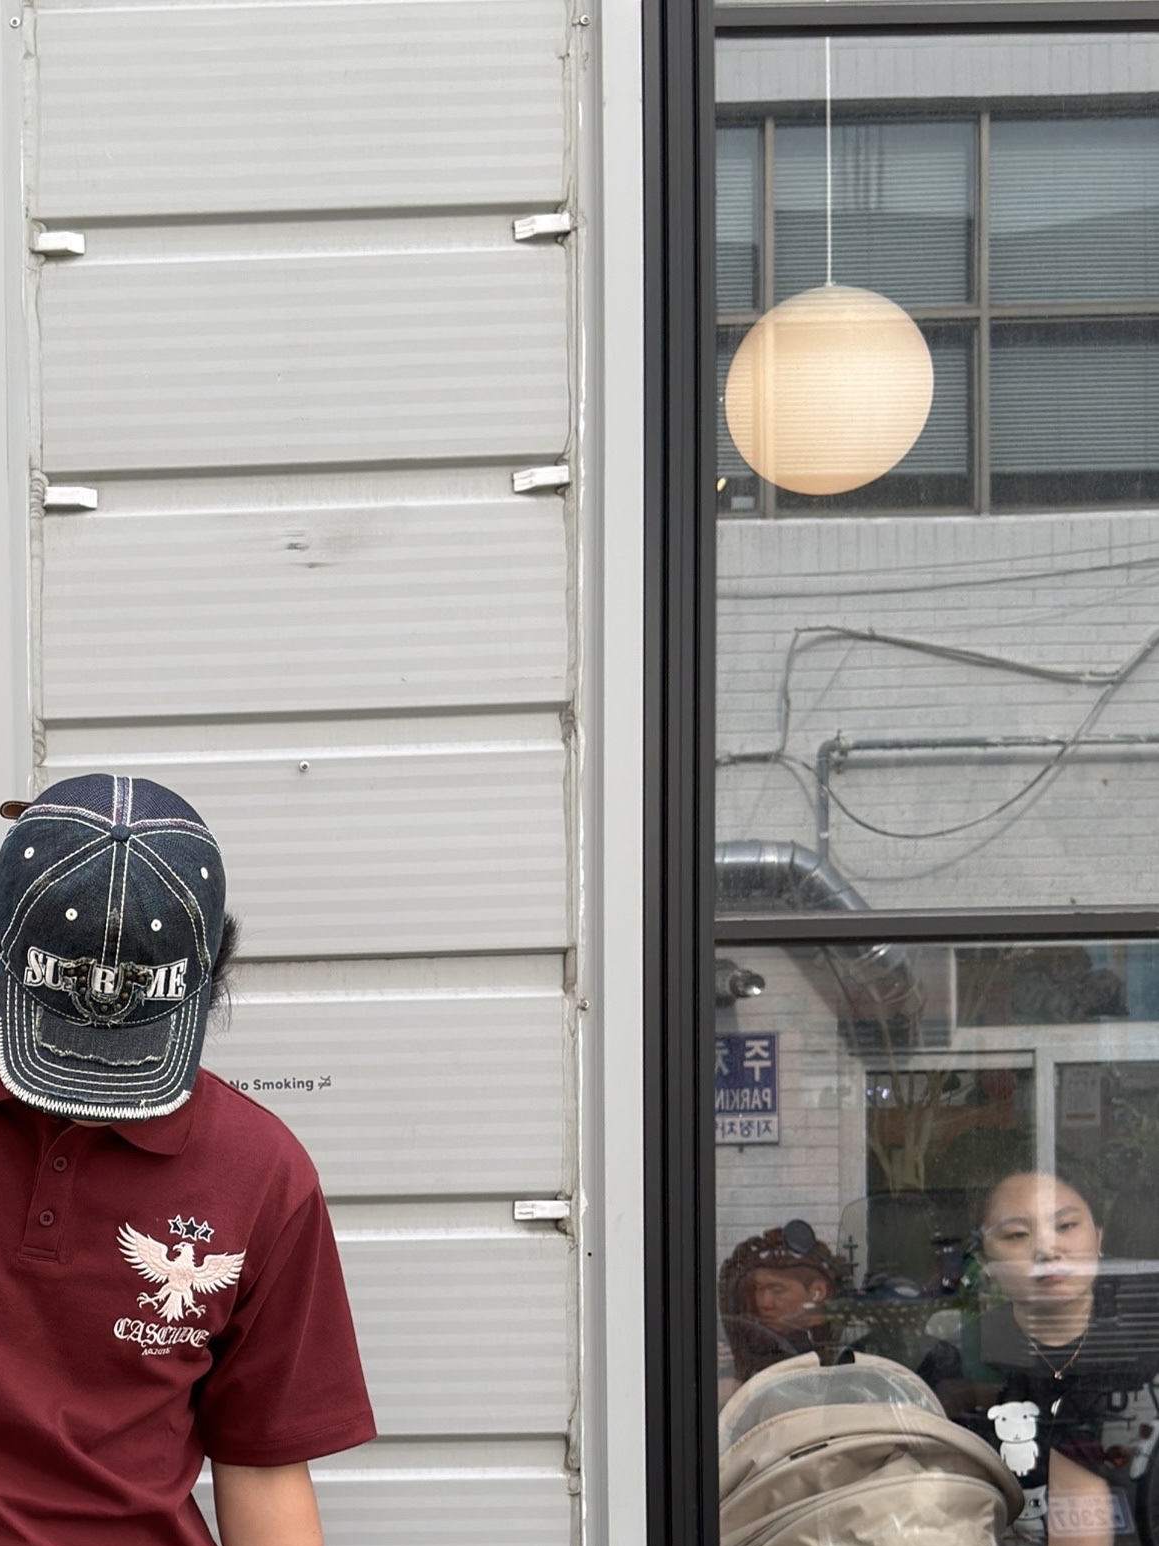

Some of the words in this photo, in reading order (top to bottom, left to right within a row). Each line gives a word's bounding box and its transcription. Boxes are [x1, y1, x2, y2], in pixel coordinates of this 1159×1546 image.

[24, 946, 189, 1001] SURME
[229, 1079, 249, 1091] No
[253, 1077, 314, 1091] Smoking
